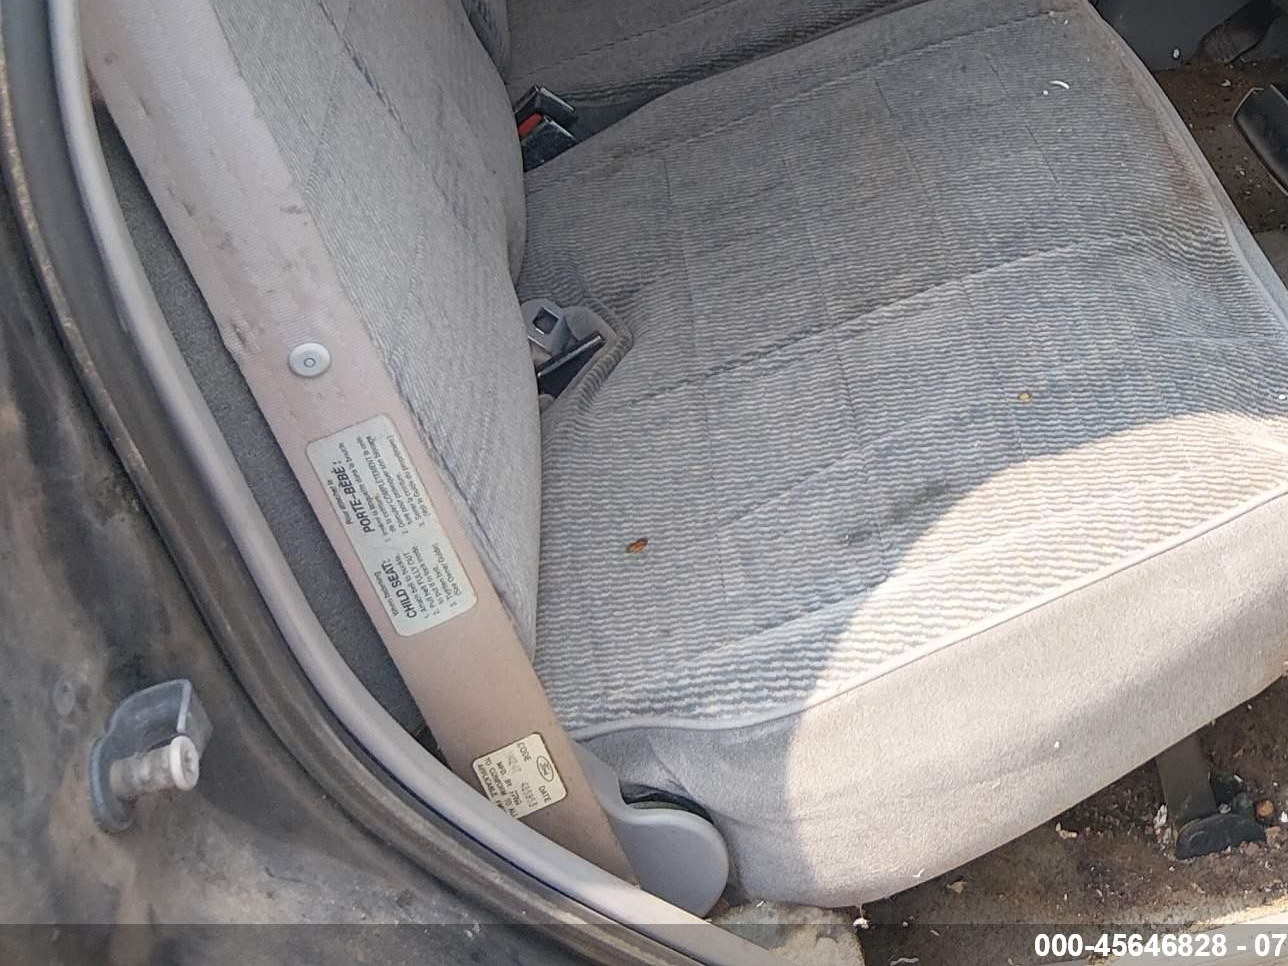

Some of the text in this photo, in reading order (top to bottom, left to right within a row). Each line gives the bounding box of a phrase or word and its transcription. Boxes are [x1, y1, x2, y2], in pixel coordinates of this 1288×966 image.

[381, 559, 416, 618] CHILD SEAT:
[518, 742, 531, 761] CODE
[539, 785, 550, 801] DATE
